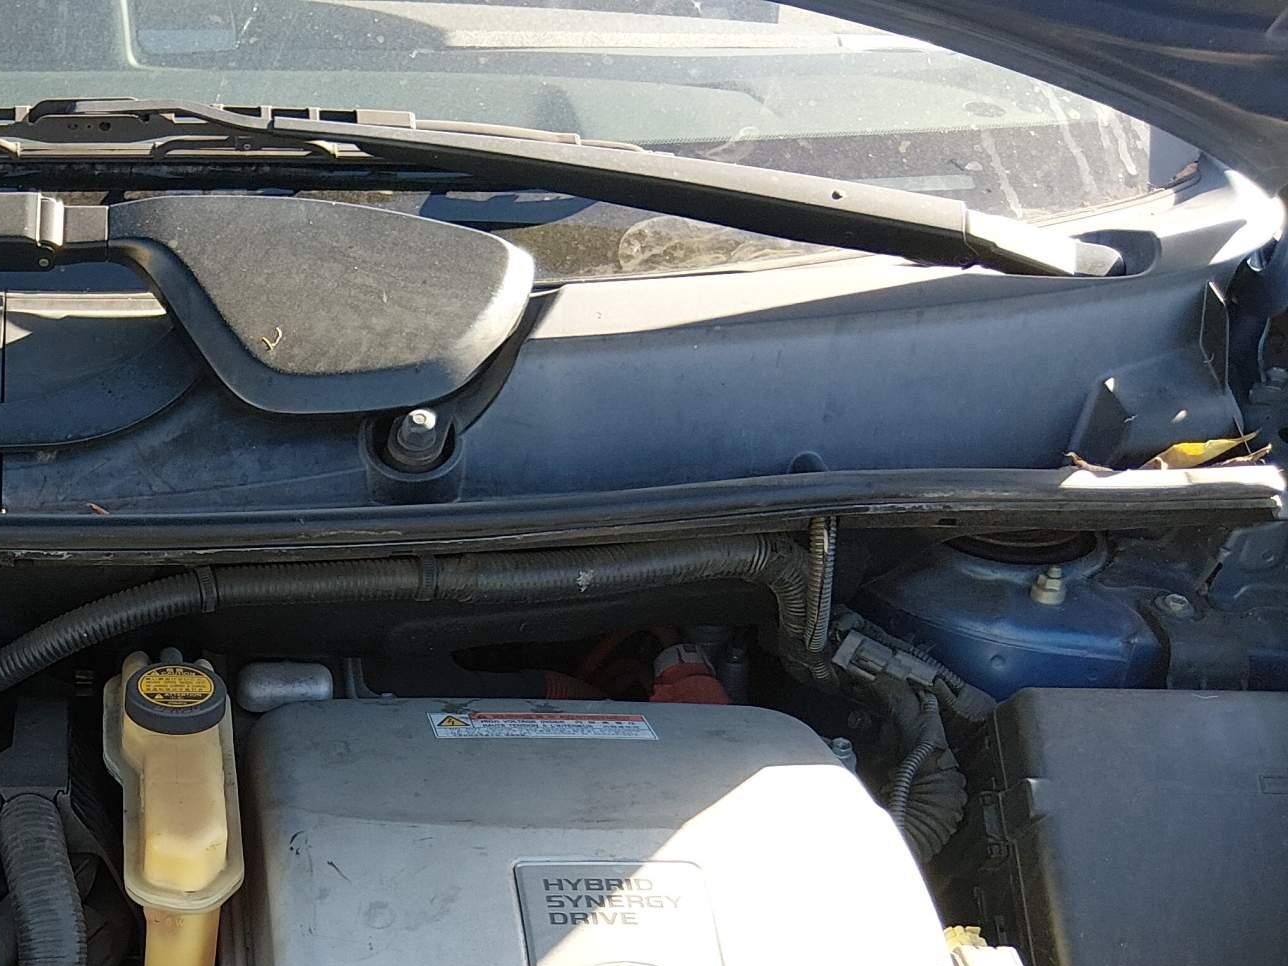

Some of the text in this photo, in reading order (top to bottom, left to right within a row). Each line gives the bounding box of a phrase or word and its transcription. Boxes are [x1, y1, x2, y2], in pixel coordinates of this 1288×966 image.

[542, 878, 653, 891] HYBRID
[545, 894, 682, 908] SYNERGY
[548, 911, 639, 925] DRIVE
